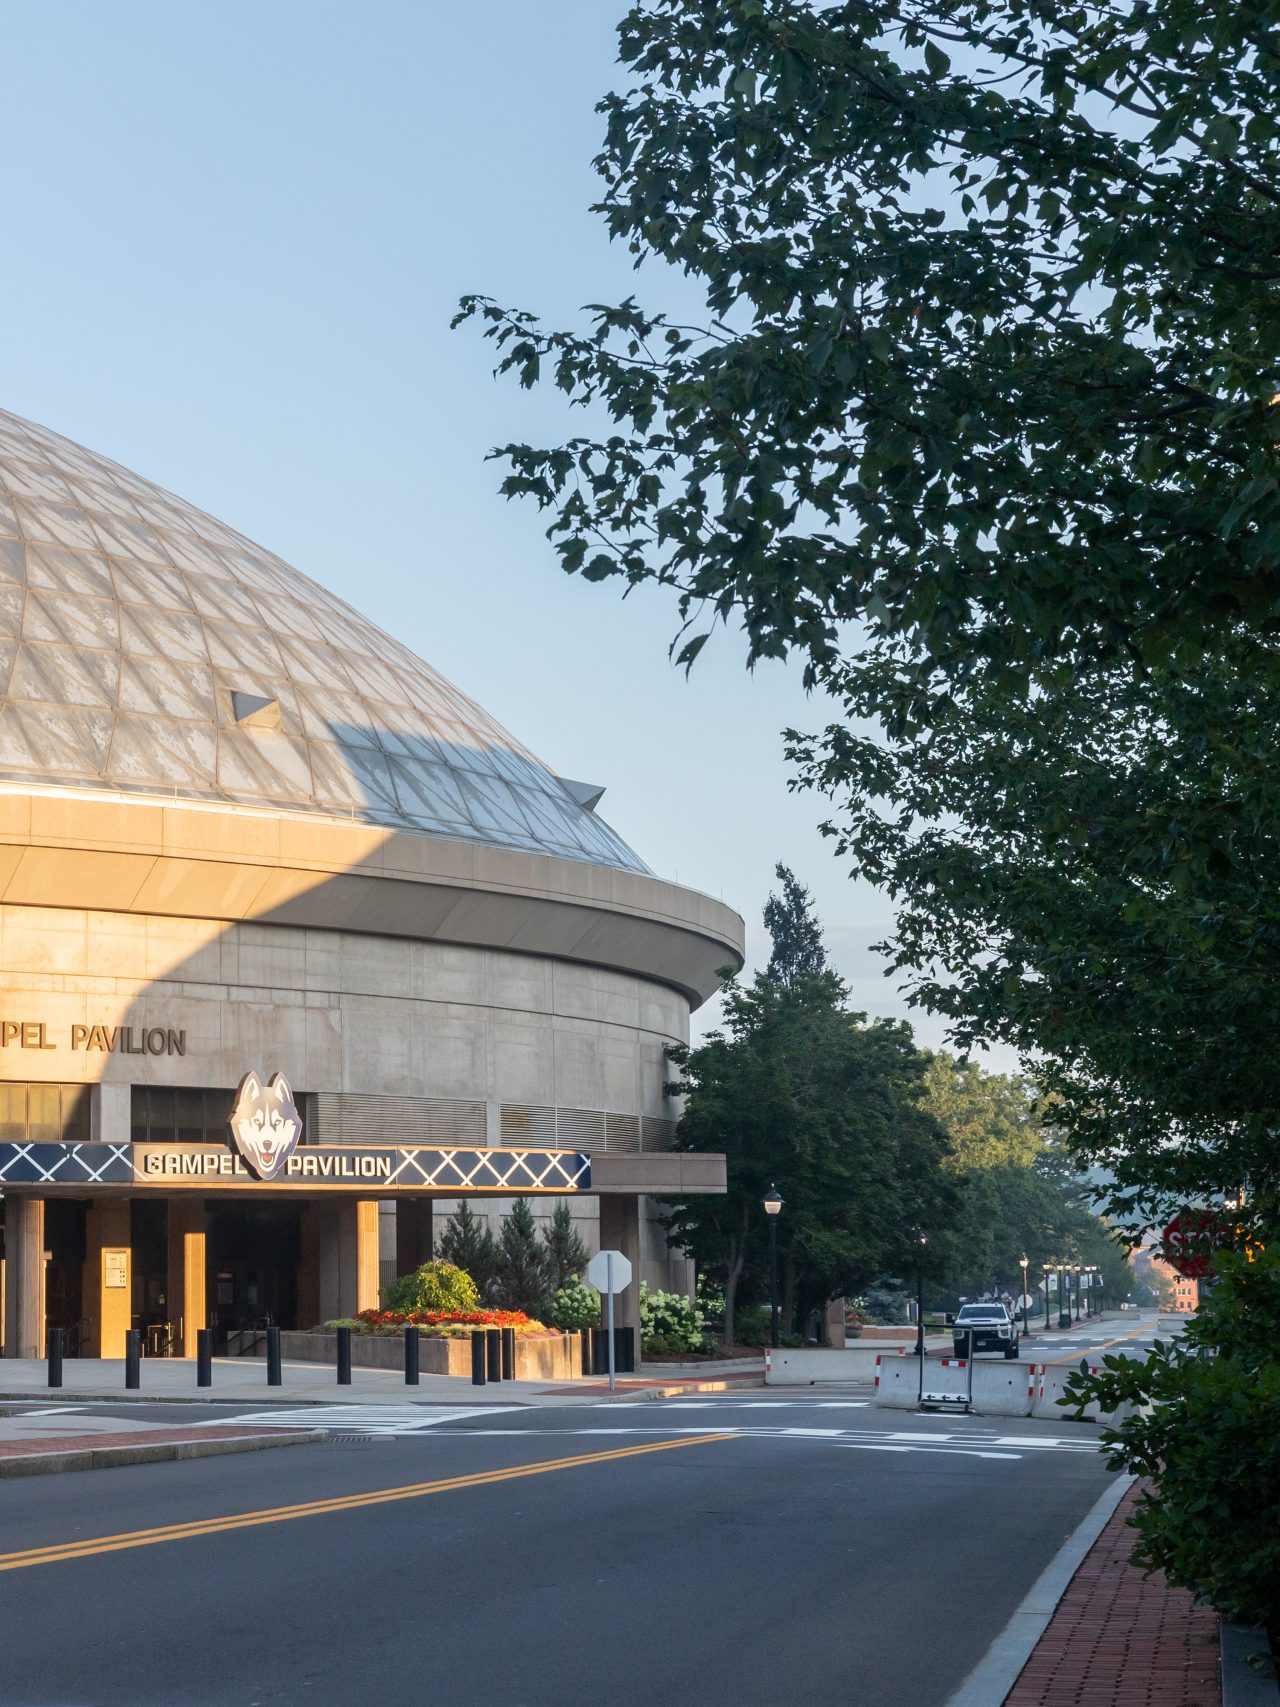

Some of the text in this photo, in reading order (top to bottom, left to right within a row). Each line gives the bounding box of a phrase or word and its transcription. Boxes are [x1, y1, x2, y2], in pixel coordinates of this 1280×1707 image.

[71, 1024, 186, 1056] PAVILION
[144, 1153, 391, 1177] GAMPEL PAVILION
